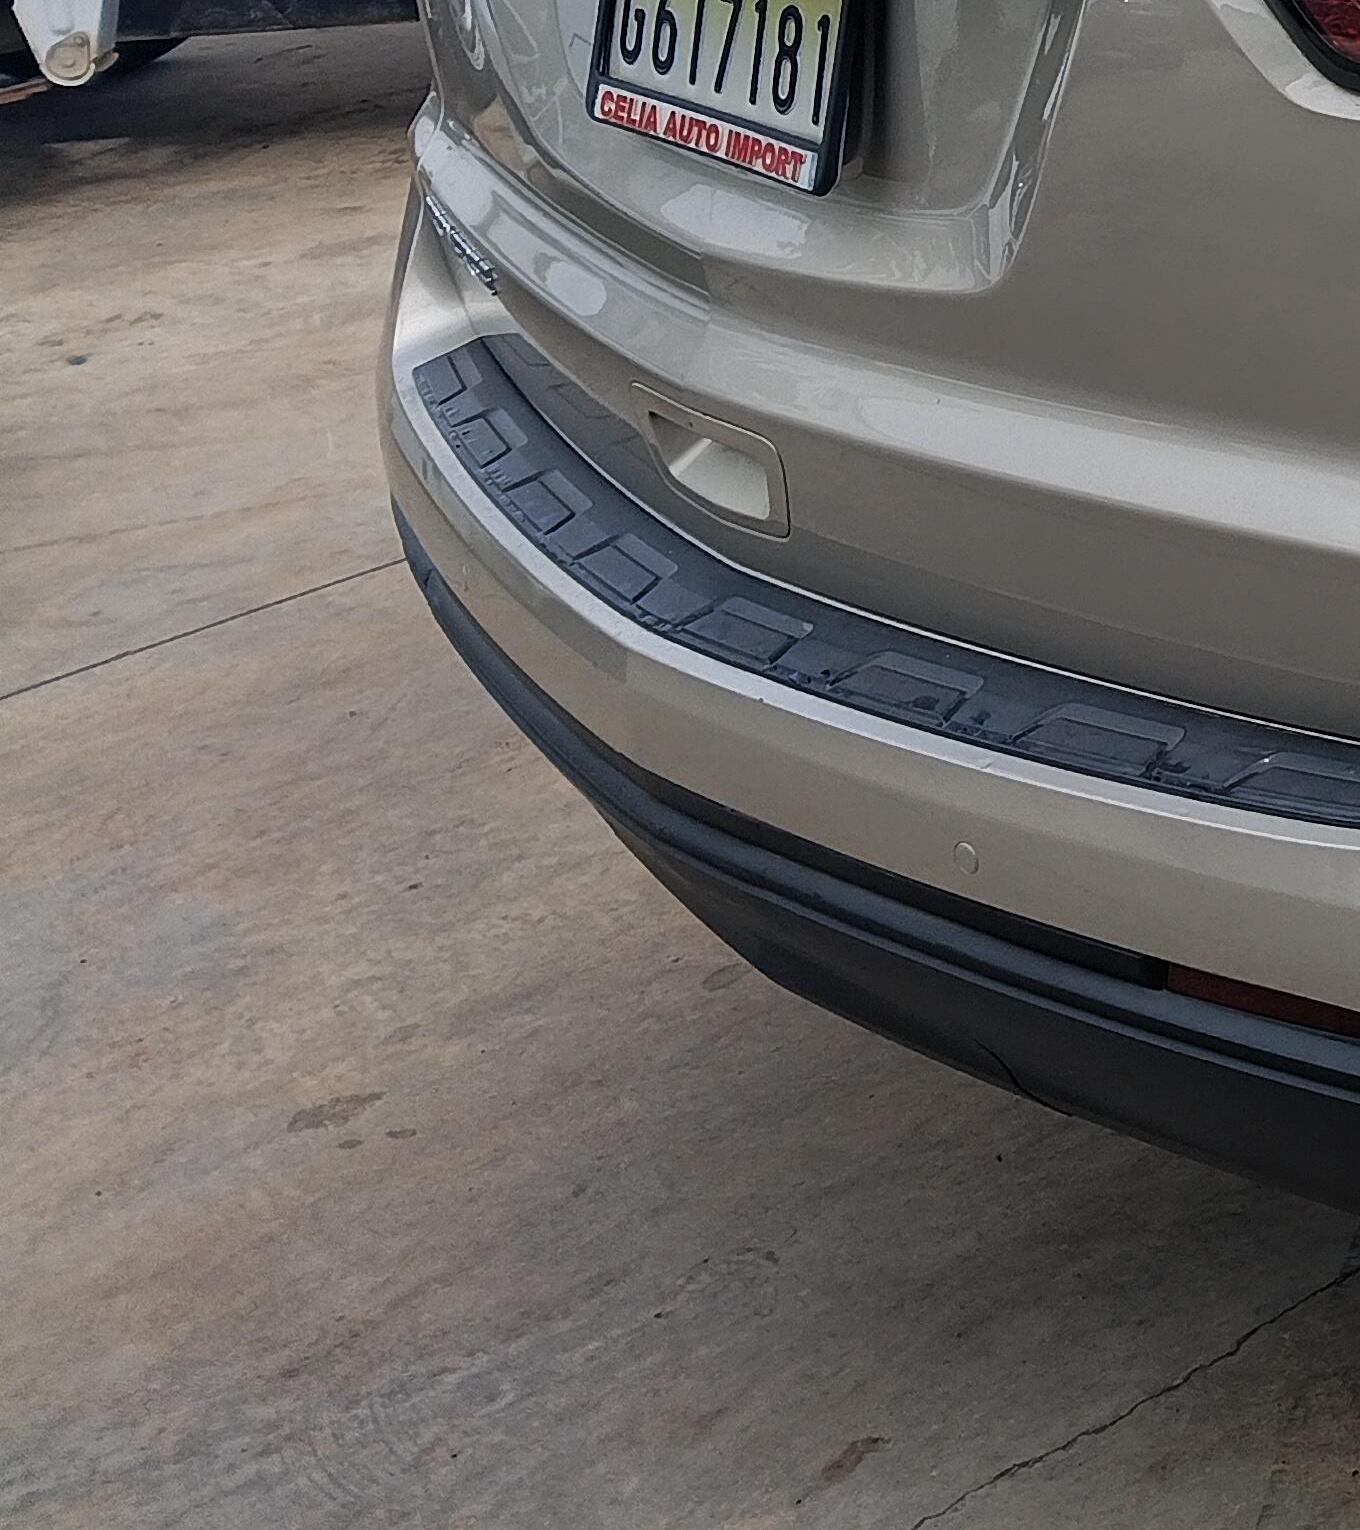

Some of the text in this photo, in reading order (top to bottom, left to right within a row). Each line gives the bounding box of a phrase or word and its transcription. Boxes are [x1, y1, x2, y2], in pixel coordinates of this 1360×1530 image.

[599, 90, 807, 184] CELIA AUTO IMPORT
